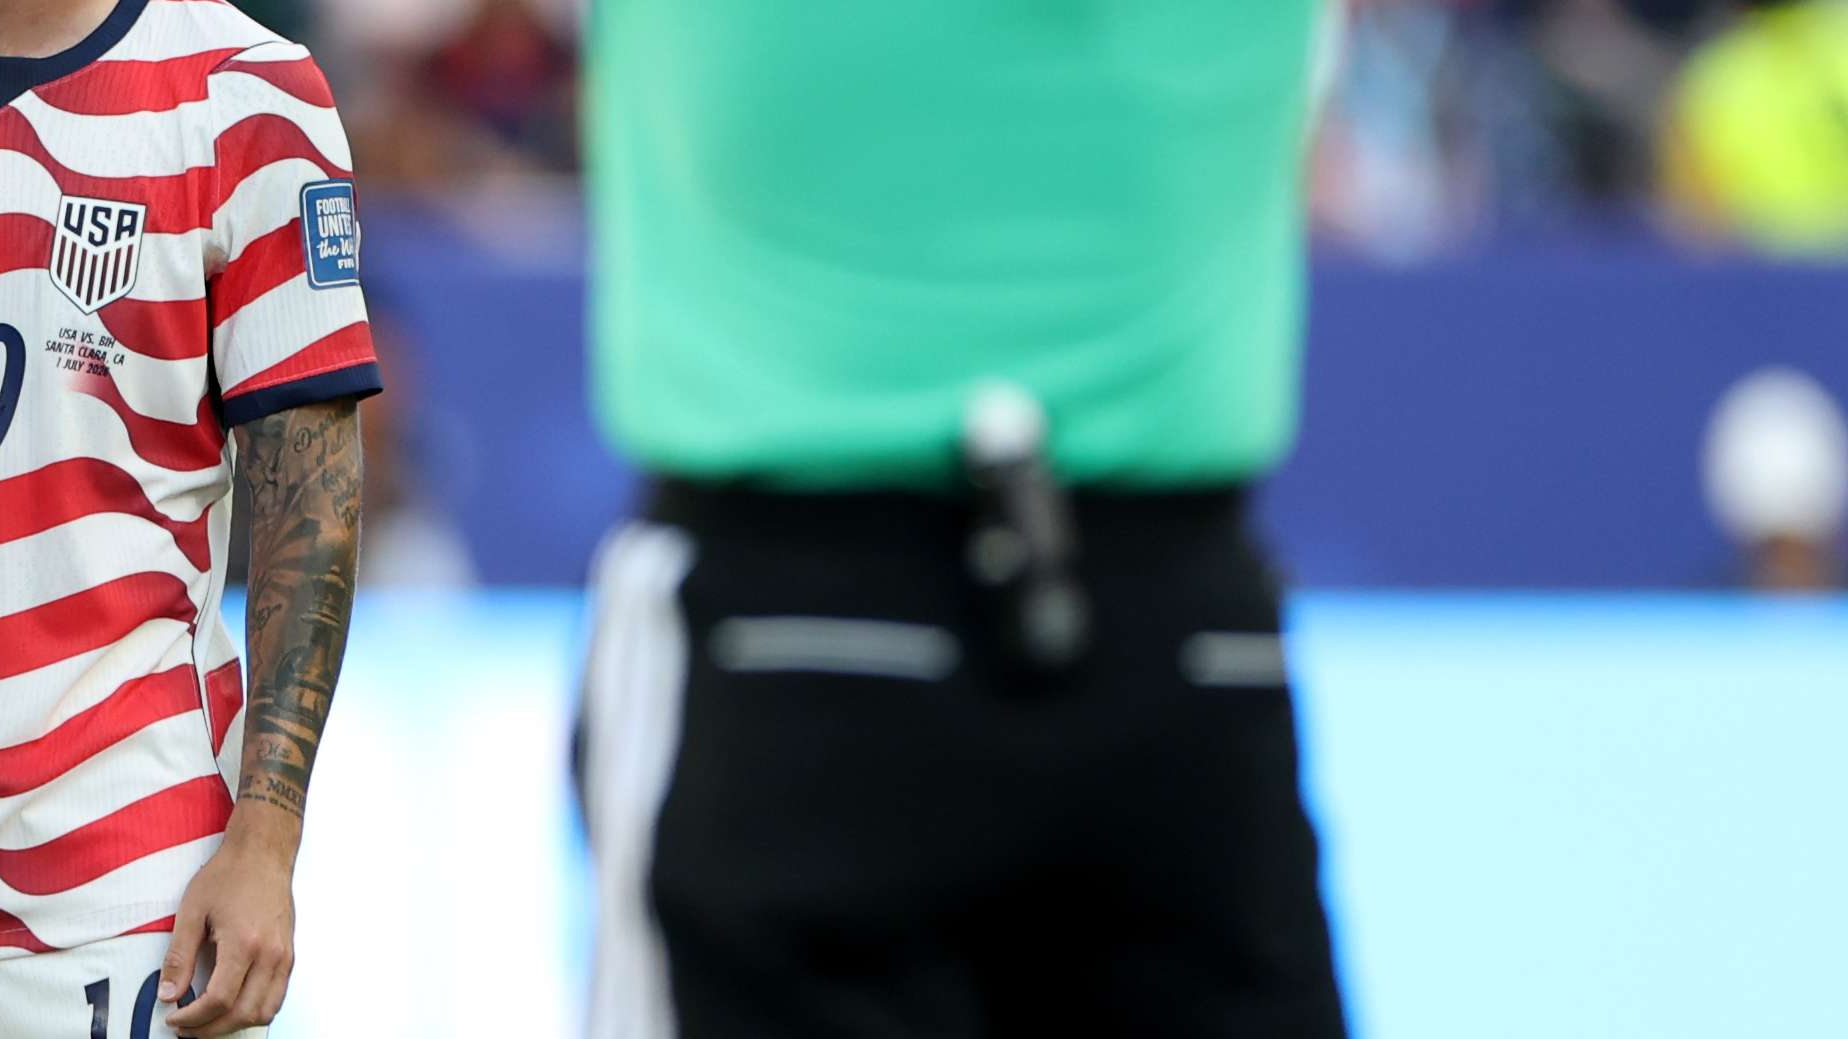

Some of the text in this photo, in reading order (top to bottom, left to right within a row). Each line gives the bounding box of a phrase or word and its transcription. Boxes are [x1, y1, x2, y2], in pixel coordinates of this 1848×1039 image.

[64, 202, 138, 247] USA
[316, 238, 340, 259] the
[59, 328, 116, 348] USA VS. BIH
[45, 340, 75, 355] SANTA
[114, 353, 125, 365] CA
[63, 358, 85, 371] JULY
